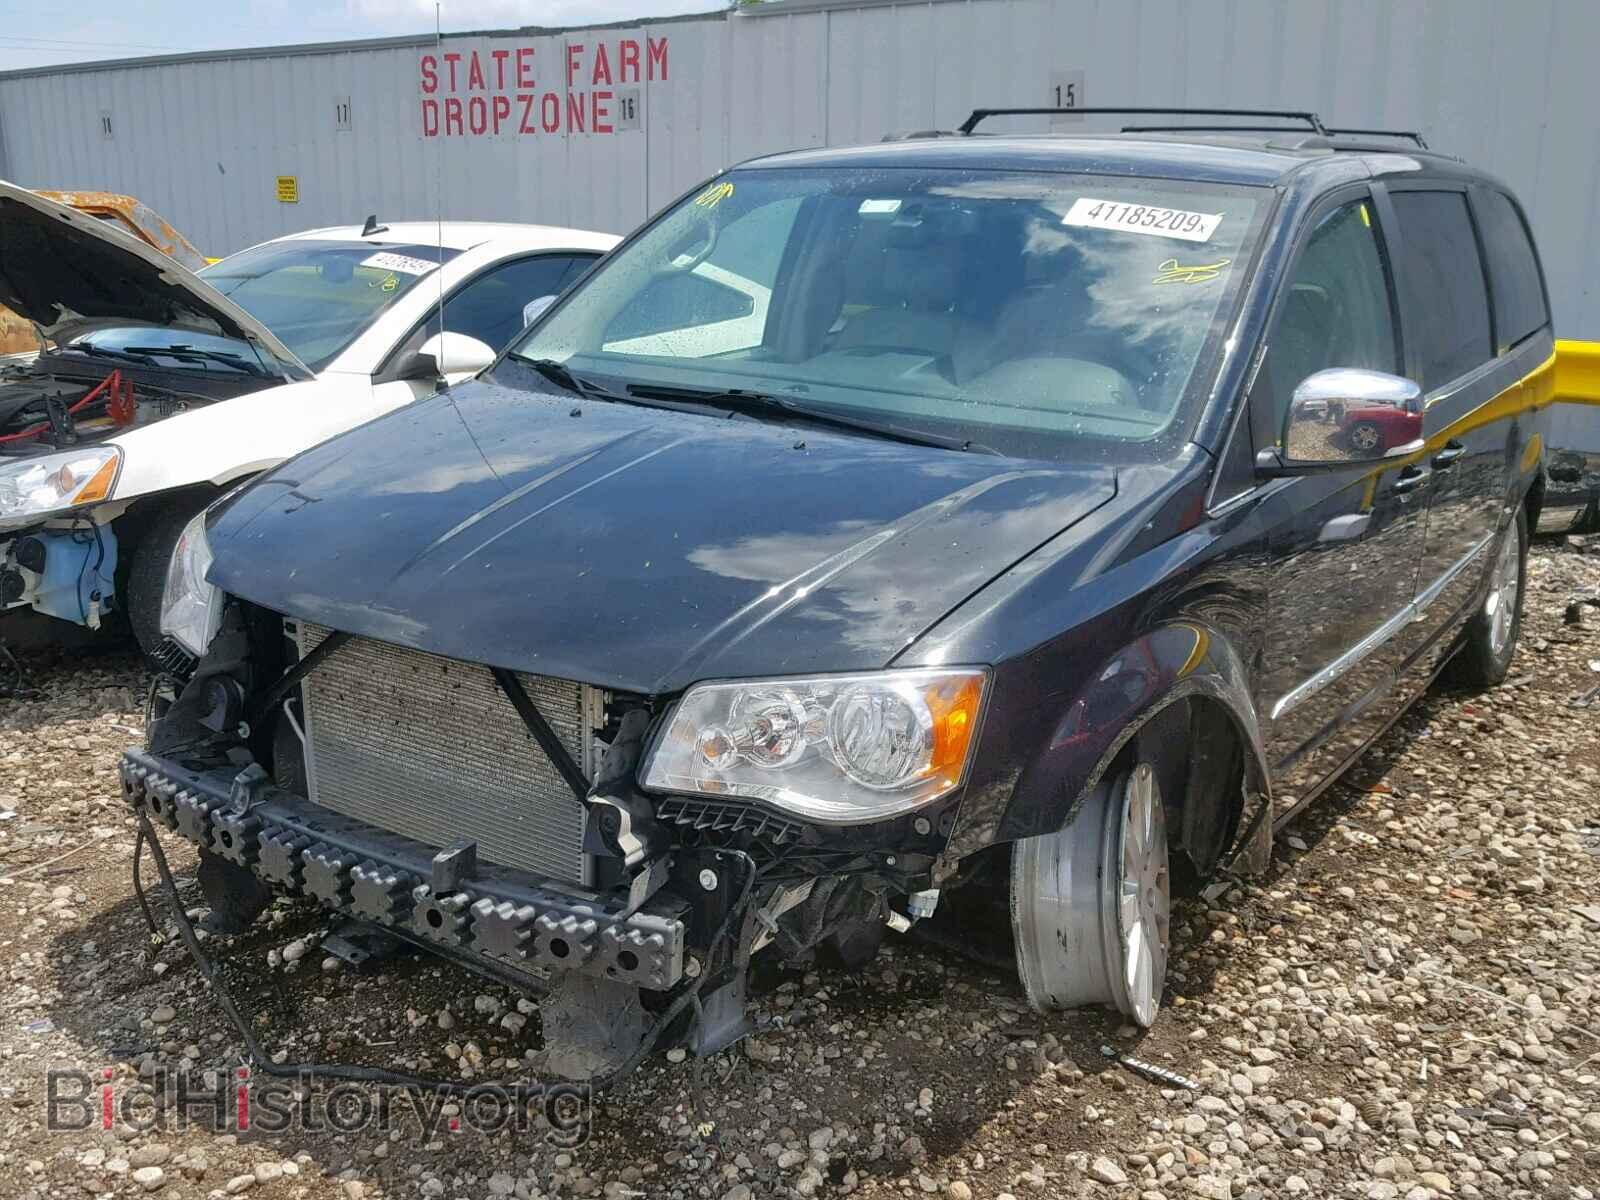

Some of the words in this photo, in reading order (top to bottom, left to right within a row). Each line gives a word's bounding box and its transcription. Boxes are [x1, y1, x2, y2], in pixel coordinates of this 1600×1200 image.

[420, 48, 536, 94] STATE
[567, 37, 668, 87] FARM
[621, 97, 635, 121] 16
[1055, 83, 1075, 108] 15
[421, 91, 614, 137] DROPZONE
